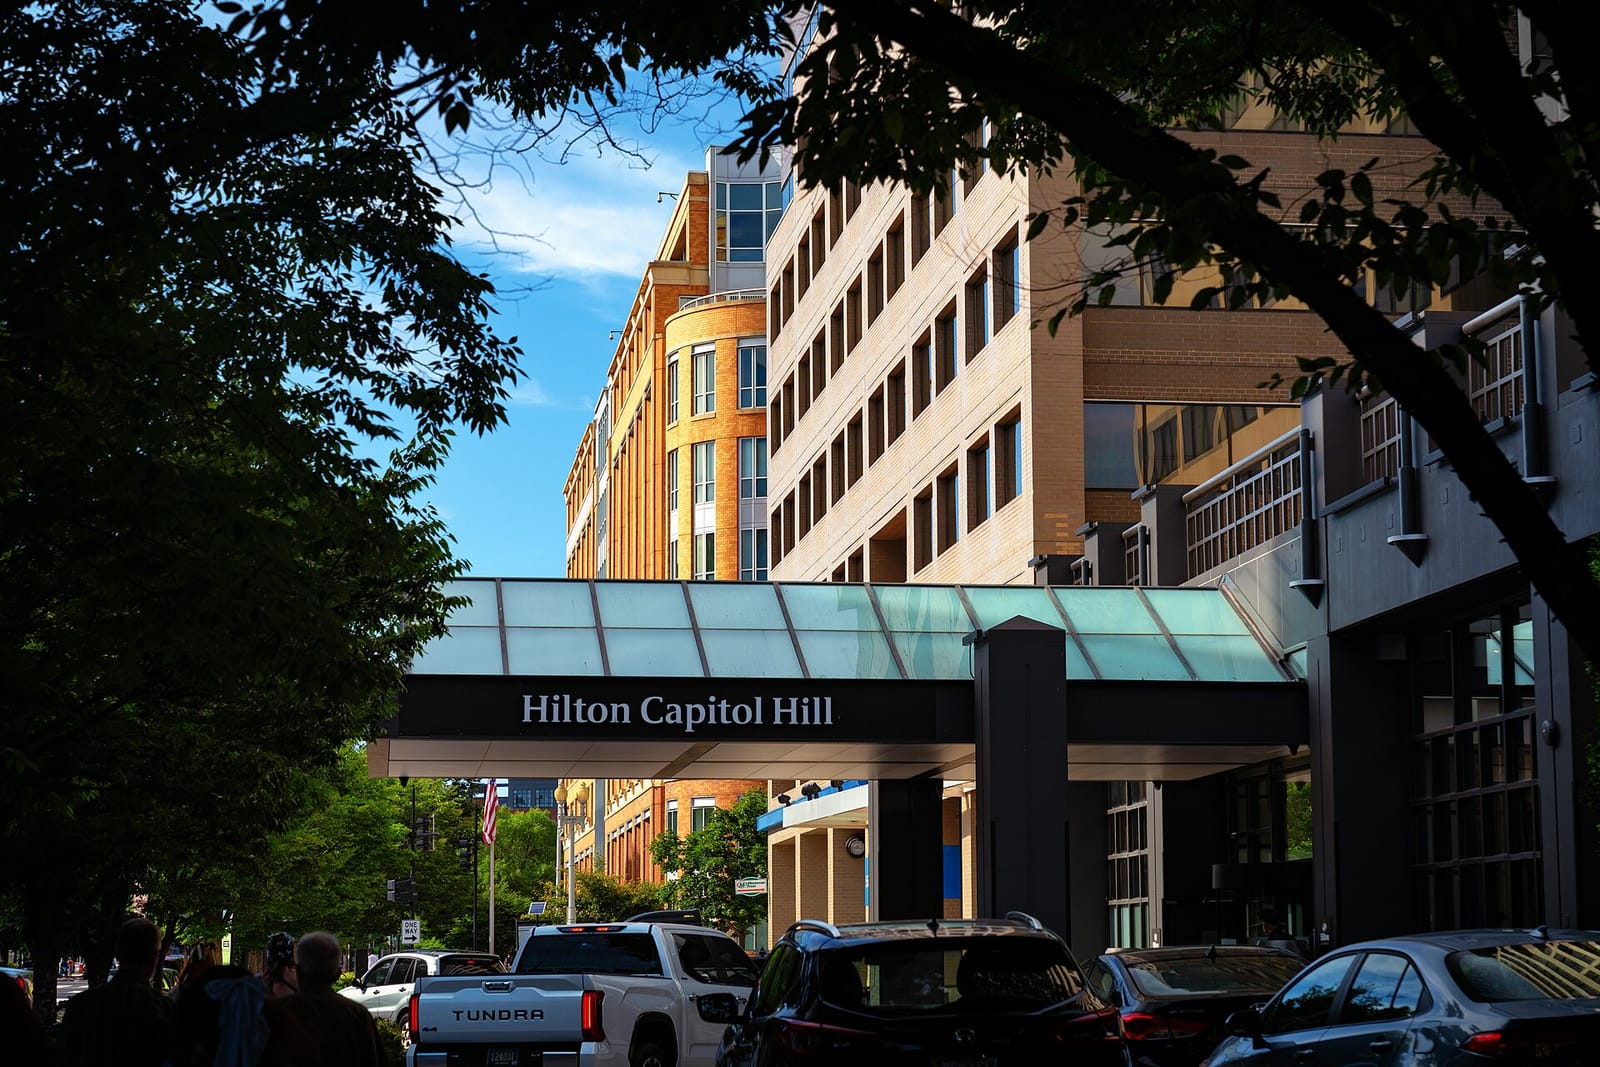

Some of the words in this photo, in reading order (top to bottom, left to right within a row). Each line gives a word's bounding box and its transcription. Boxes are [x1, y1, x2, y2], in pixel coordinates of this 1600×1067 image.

[521, 694, 632, 724] Hilton
[640, 695, 764, 733] Capitol
[772, 696, 833, 725] Hill
[452, 1009, 544, 1022] TUNDRA
